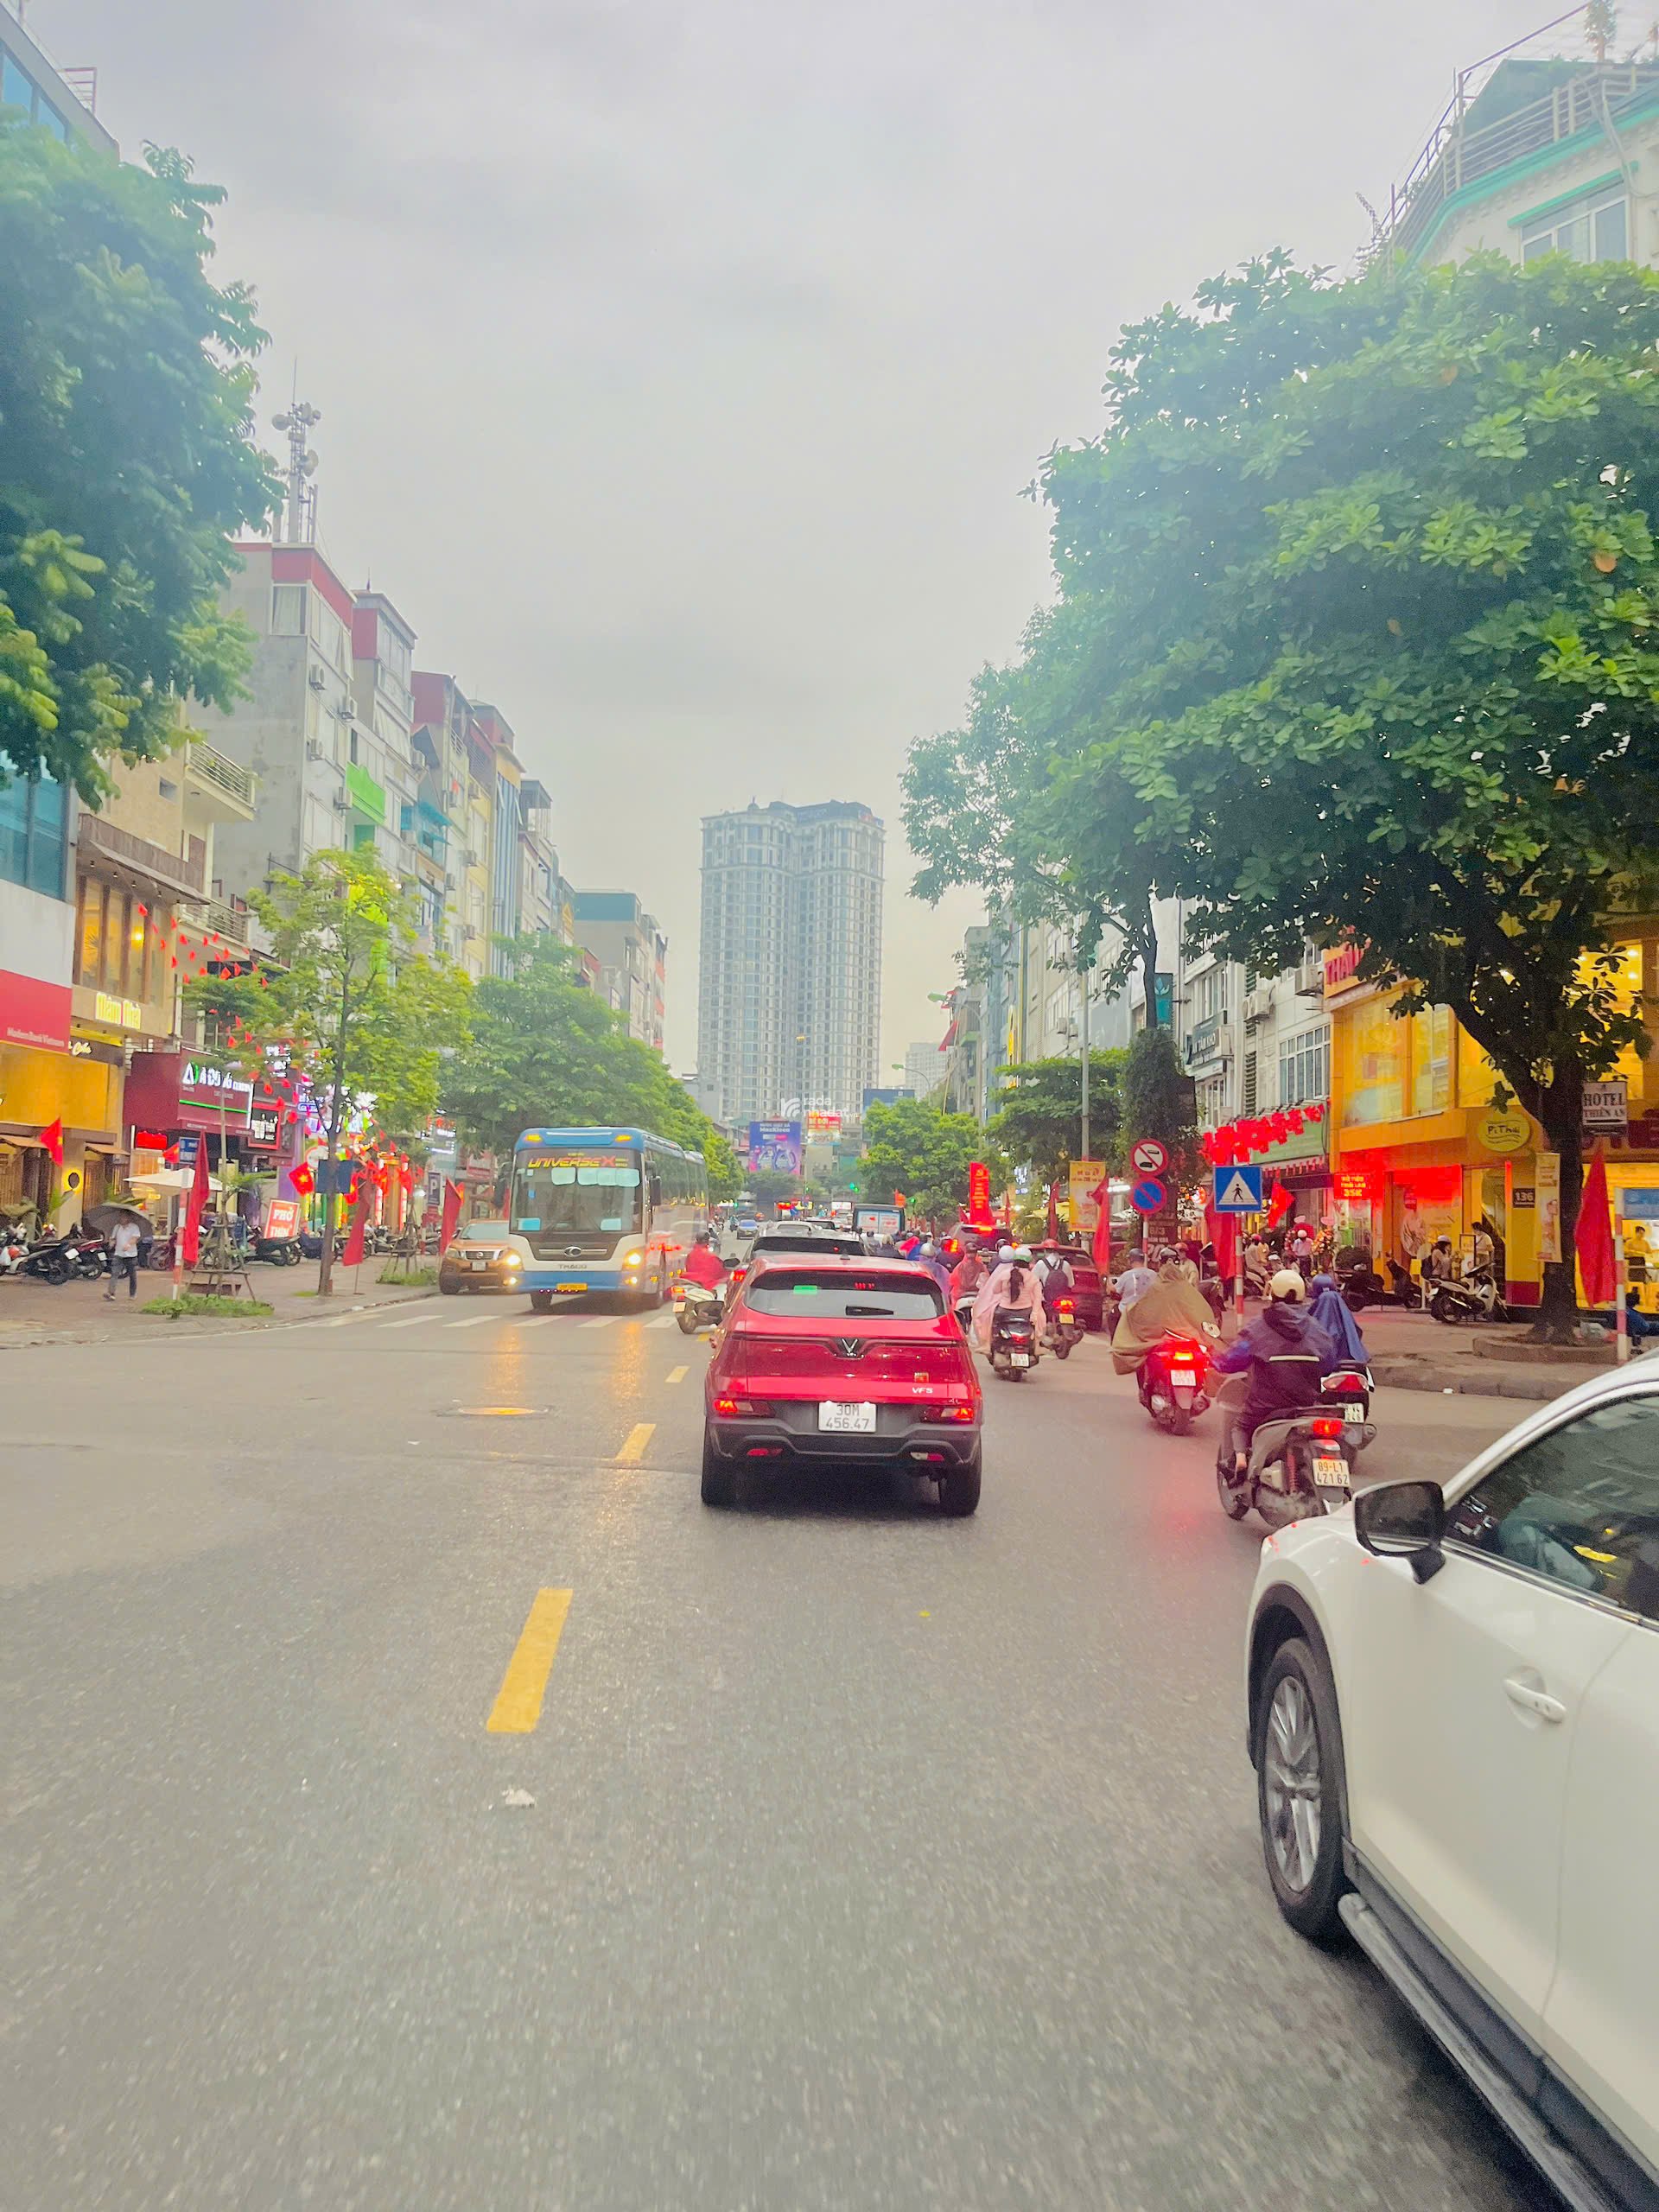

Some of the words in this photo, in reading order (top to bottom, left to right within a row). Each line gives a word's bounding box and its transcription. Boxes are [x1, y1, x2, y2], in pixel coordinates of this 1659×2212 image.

[1583, 1092, 1625, 1106] HOTEL
[1515, 1192, 1535, 1202] 136
[836, 1404, 861, 1416] 30M
[825, 1417, 870, 1430] 456.47
